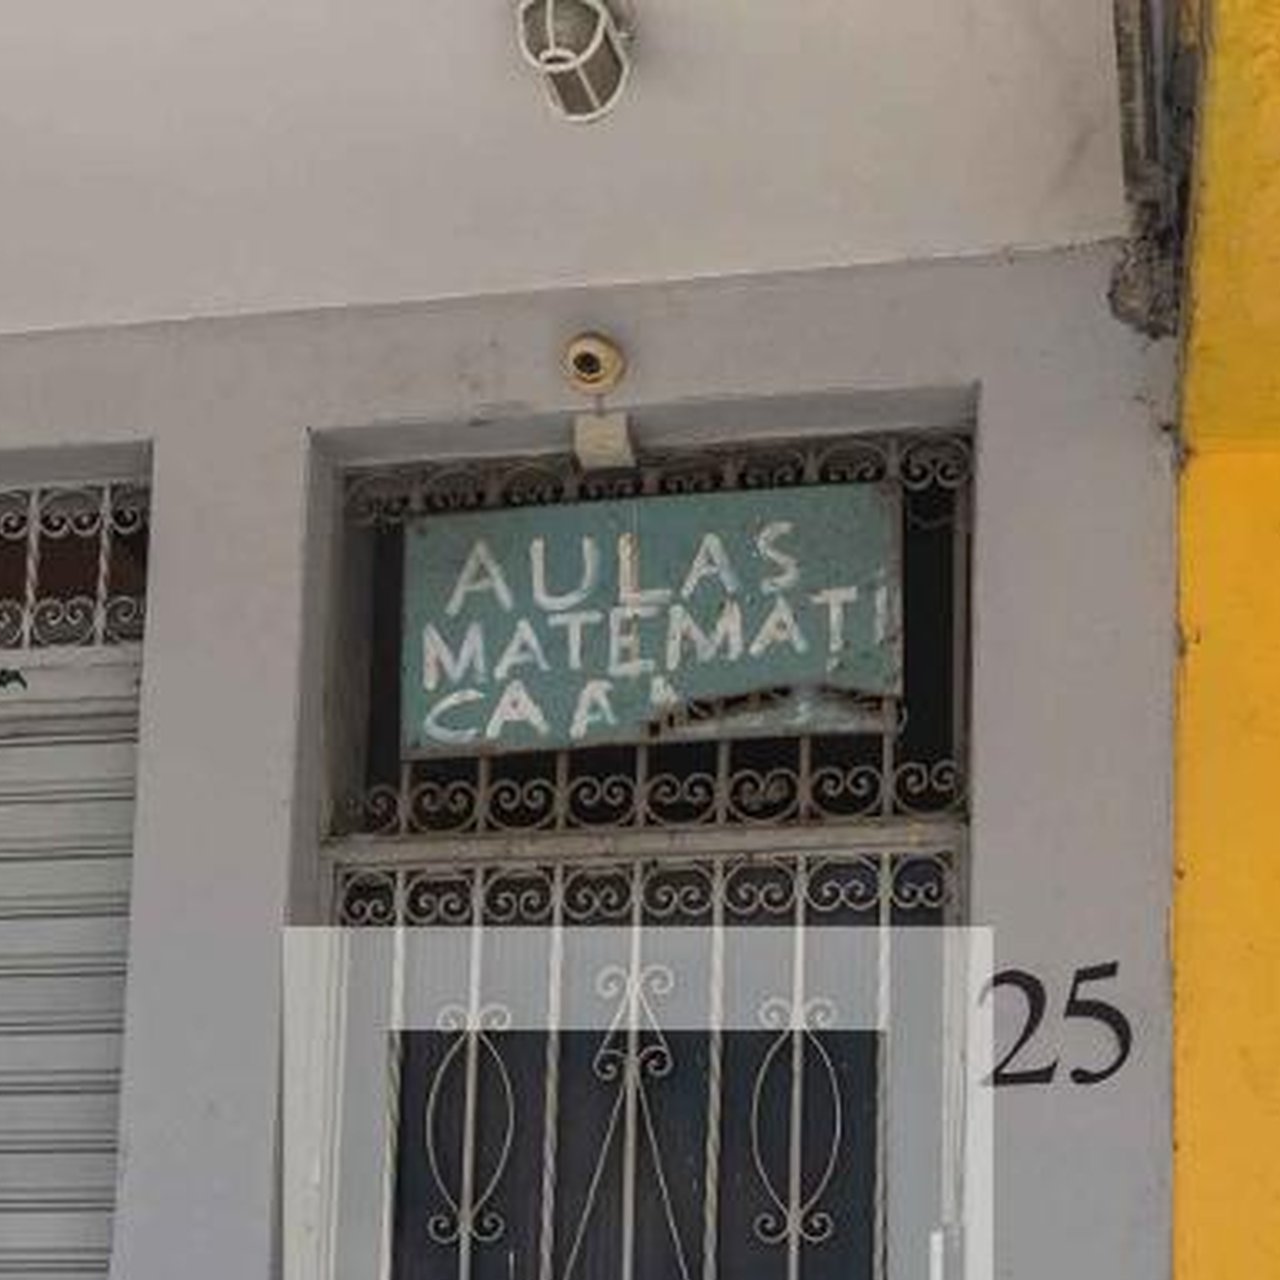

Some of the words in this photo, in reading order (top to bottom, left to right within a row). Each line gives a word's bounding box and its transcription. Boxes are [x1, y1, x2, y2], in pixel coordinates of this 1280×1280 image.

[445, 520, 801, 616] AULAS
[422, 584, 890, 691] MATEMATI
[977, 961, 1132, 1086] 25
